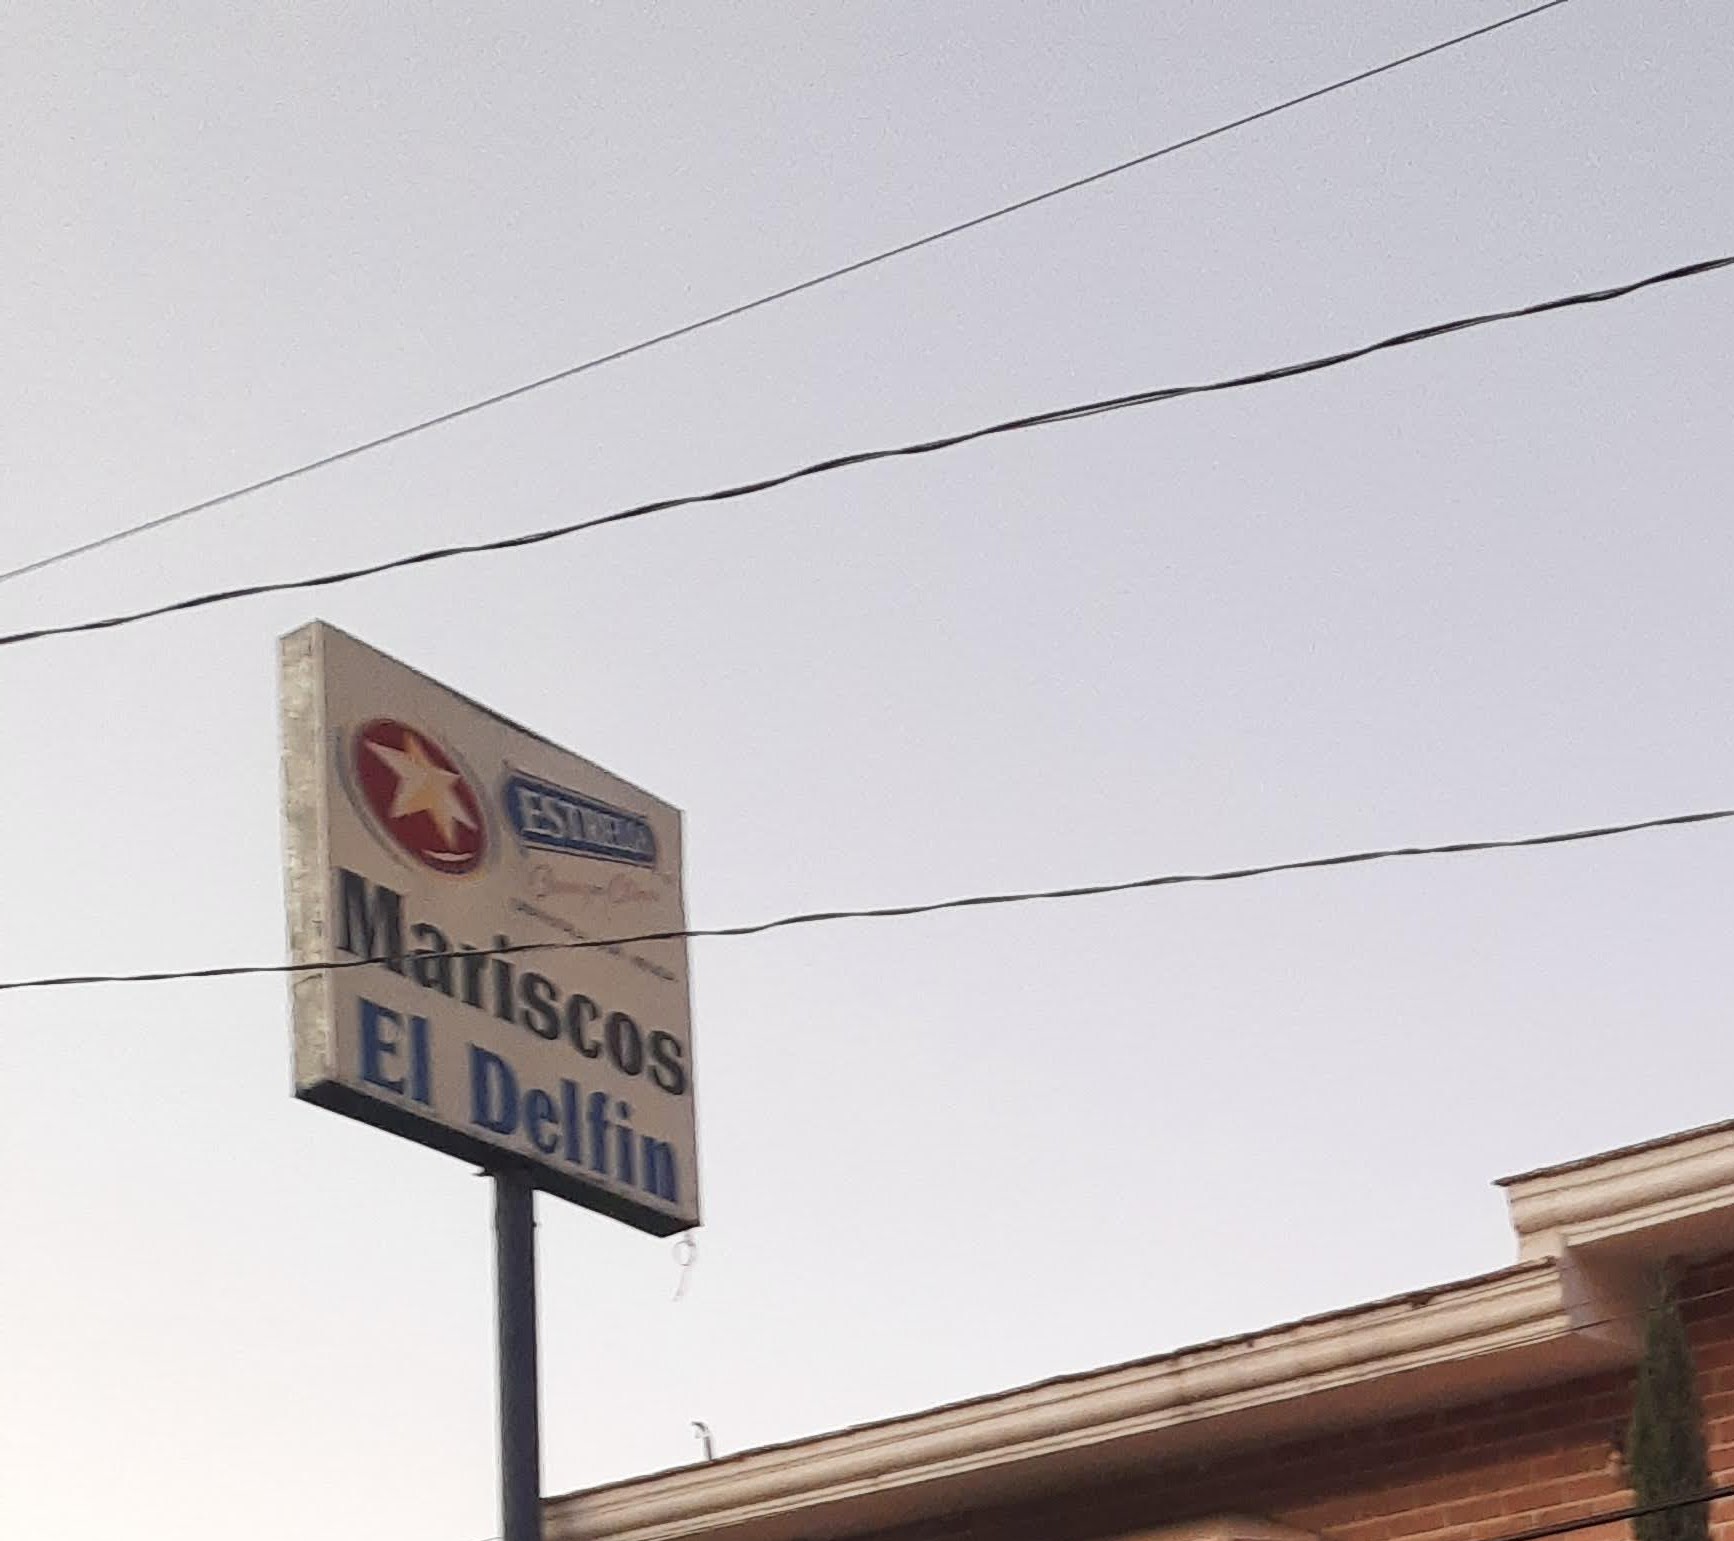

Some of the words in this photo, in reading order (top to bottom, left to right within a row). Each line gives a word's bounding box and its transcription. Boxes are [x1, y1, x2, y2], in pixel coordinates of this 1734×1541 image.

[333, 866, 686, 1096] Mariscos
[357, 996, 431, 1106] El
[468, 1042, 679, 1202] Delfin
